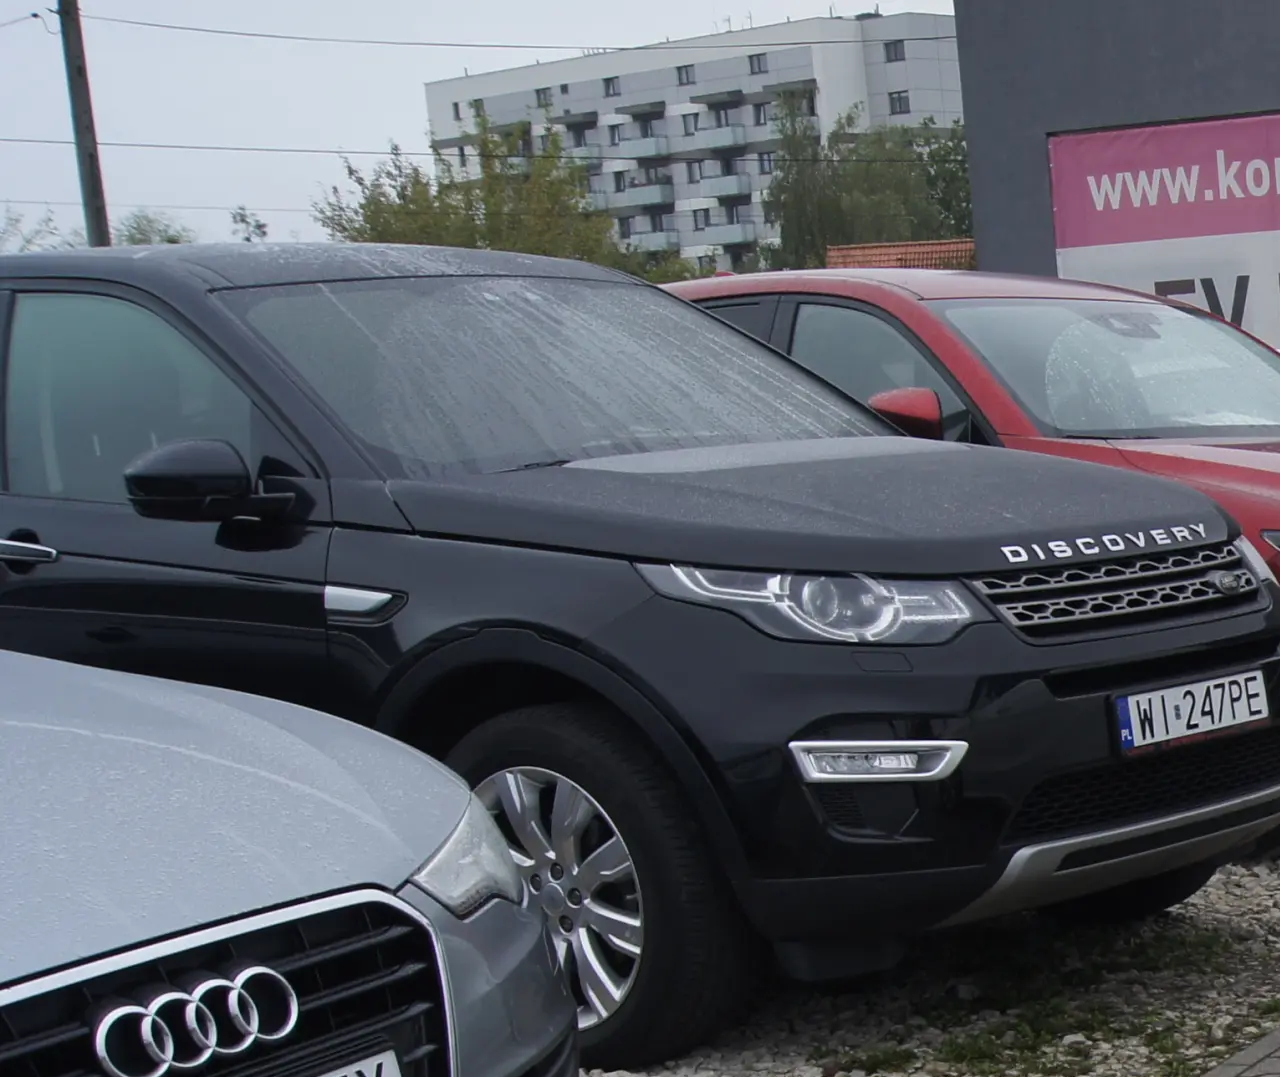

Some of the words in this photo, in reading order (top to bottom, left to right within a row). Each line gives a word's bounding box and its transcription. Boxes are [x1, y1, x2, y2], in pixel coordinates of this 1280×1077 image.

[1154, 274, 1250, 329] V
[1001, 523, 1207, 563] DISCOVERY
[1136, 694, 1170, 740] WI
[1183, 676, 1262, 730] 247PE
[1121, 729, 1132, 741] PL
